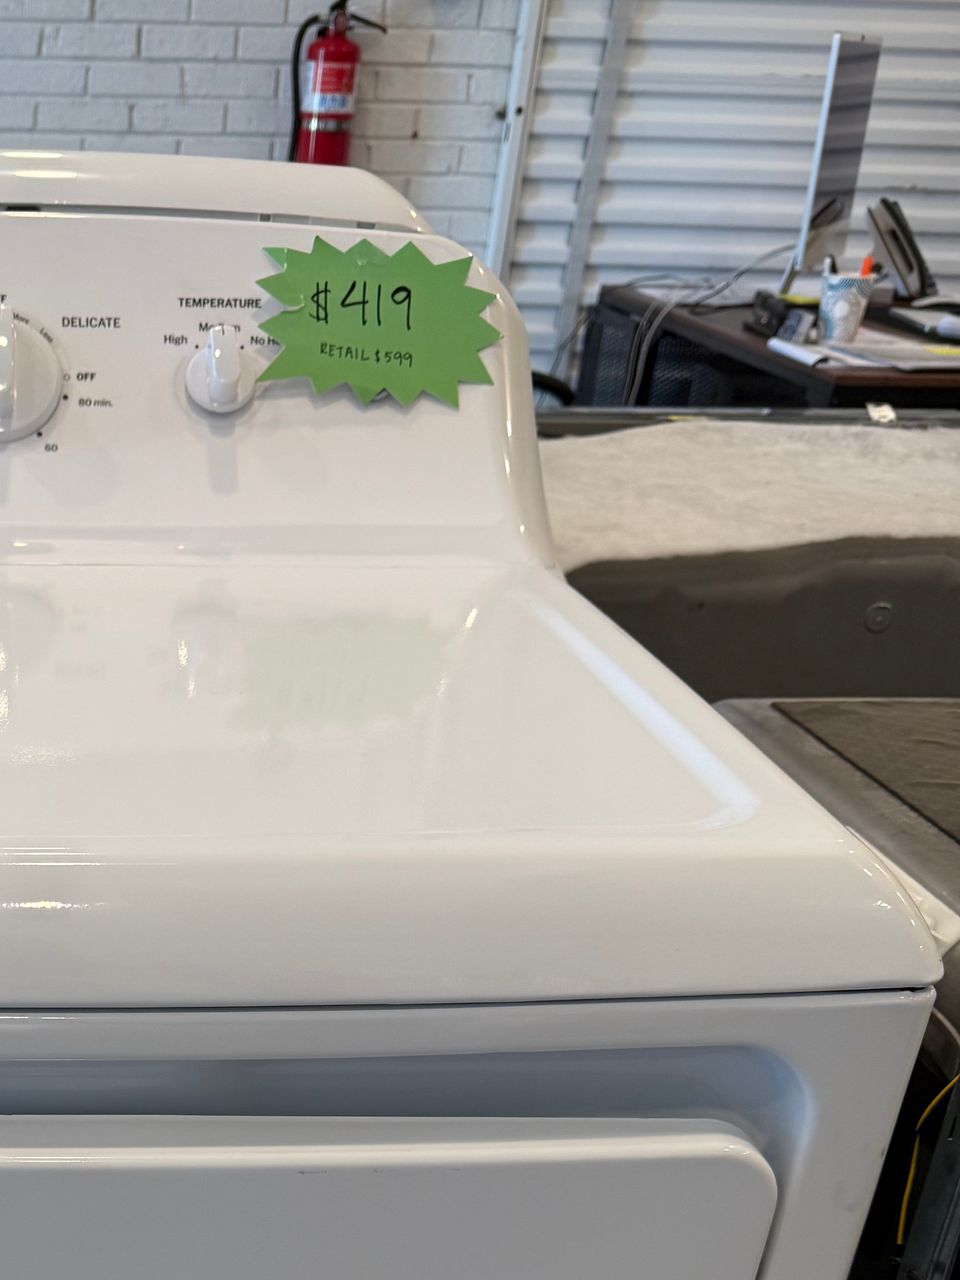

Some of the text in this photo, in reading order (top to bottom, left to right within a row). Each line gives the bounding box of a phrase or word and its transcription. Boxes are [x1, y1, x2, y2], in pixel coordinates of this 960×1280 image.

[177, 297, 262, 309] TEMPERATURE
[308, 280, 412, 331] $419
[61, 316, 121, 329] DELICATE
[163, 334, 189, 346] High
[250, 336, 266, 346] No
[320, 342, 413, 368] RETAIL $599
[76, 372, 97, 382] OFF
[78, 398, 114, 408] 80 min.
[44, 443, 59, 453] 60
